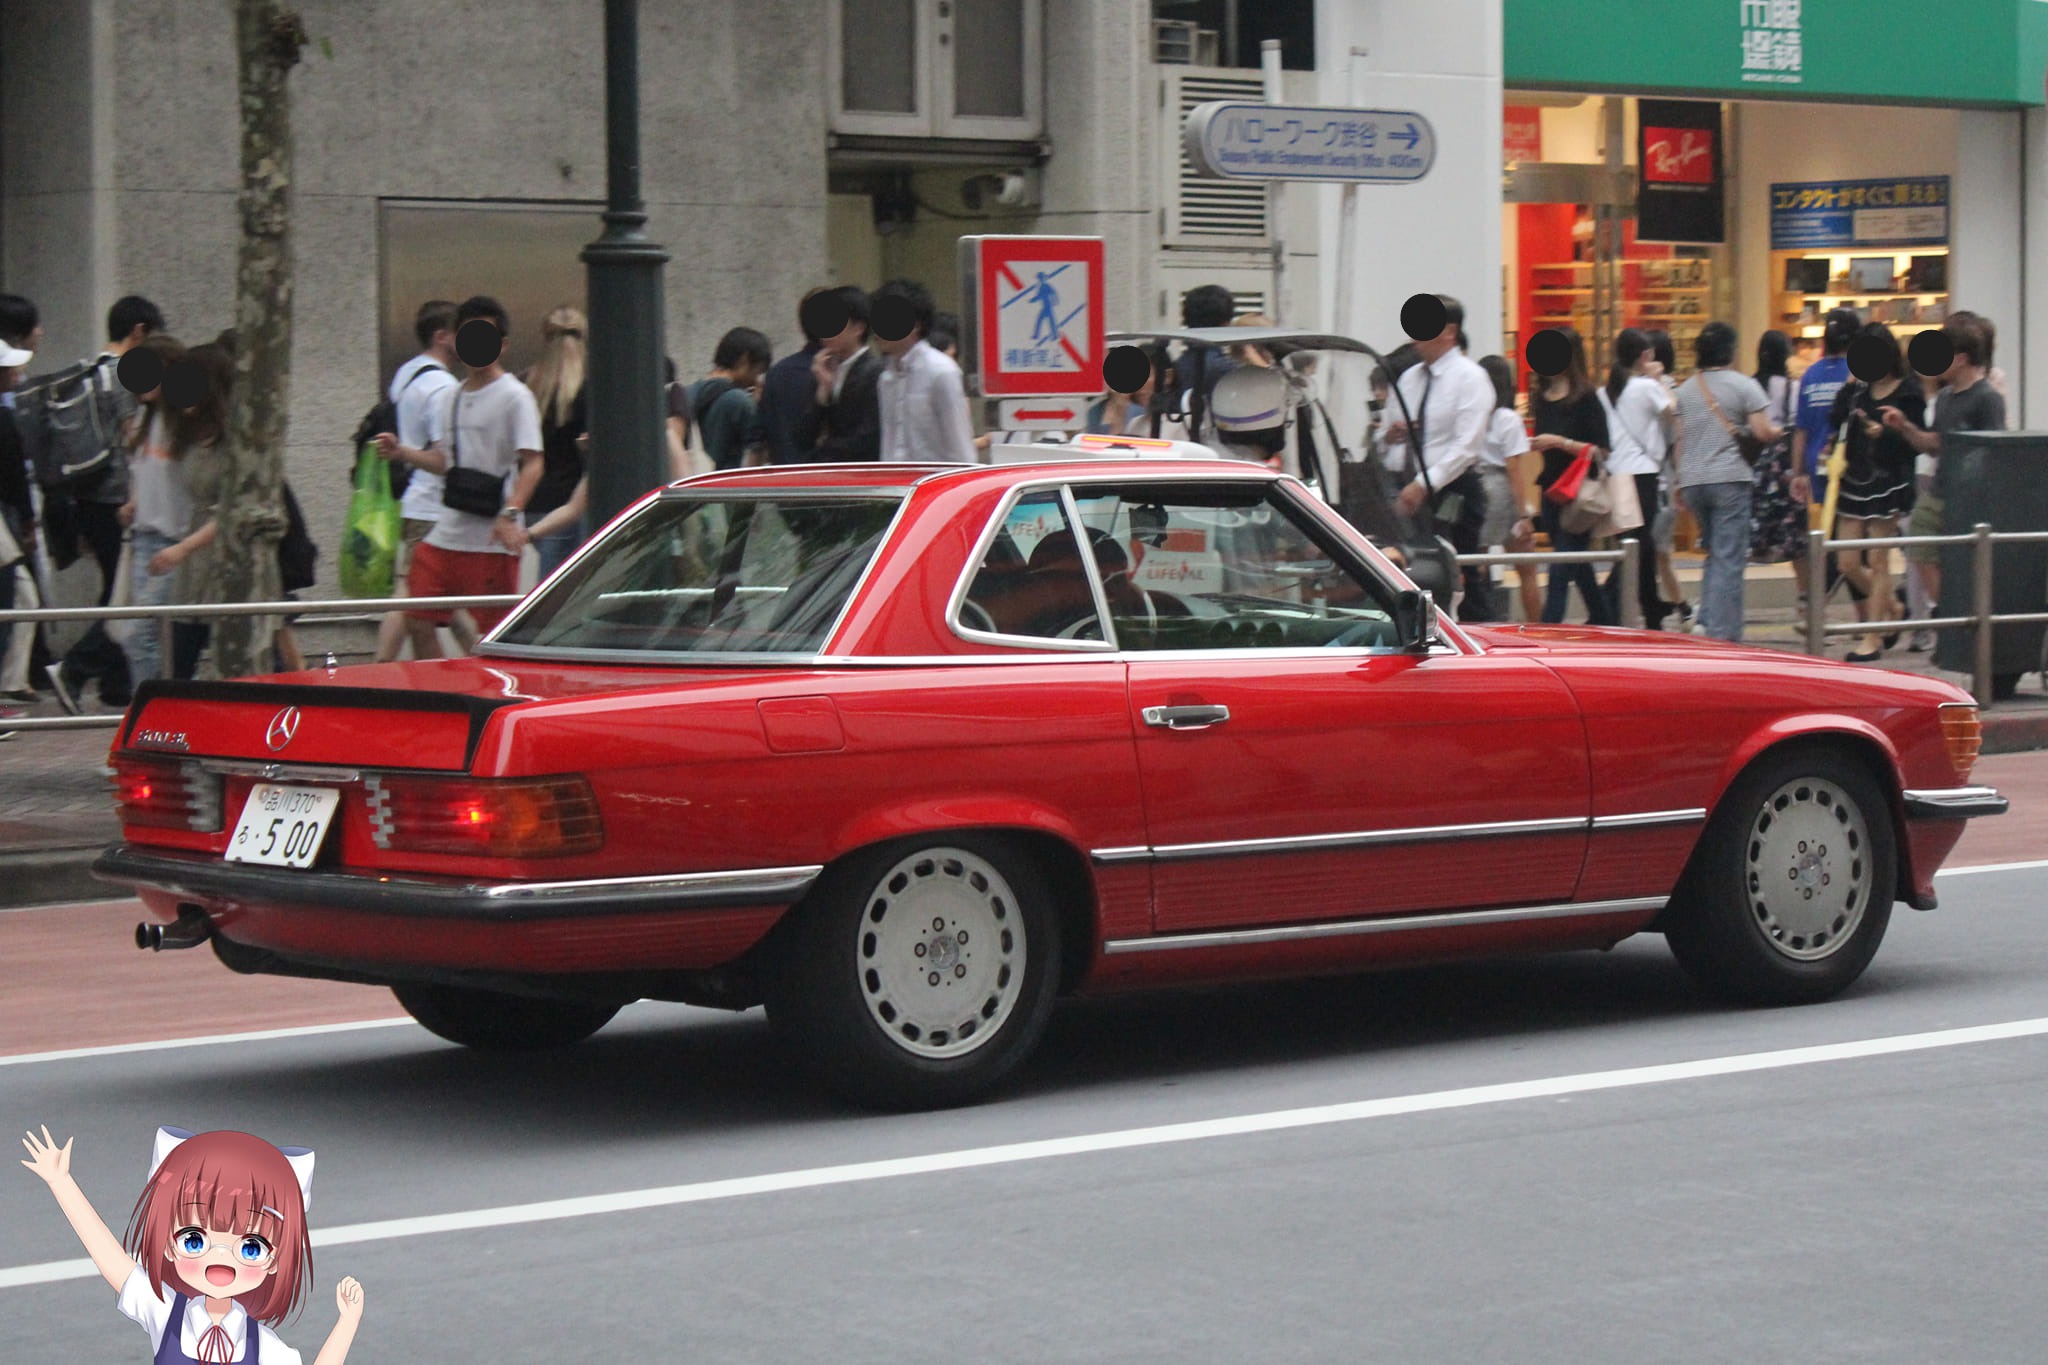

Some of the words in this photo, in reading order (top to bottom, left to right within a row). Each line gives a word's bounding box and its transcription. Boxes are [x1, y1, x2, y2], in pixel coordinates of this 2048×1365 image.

[1224, 118, 1377, 148] ハローワーク渋谷
[264, 790, 291, 811] 品川
[289, 792, 316, 814] 370
